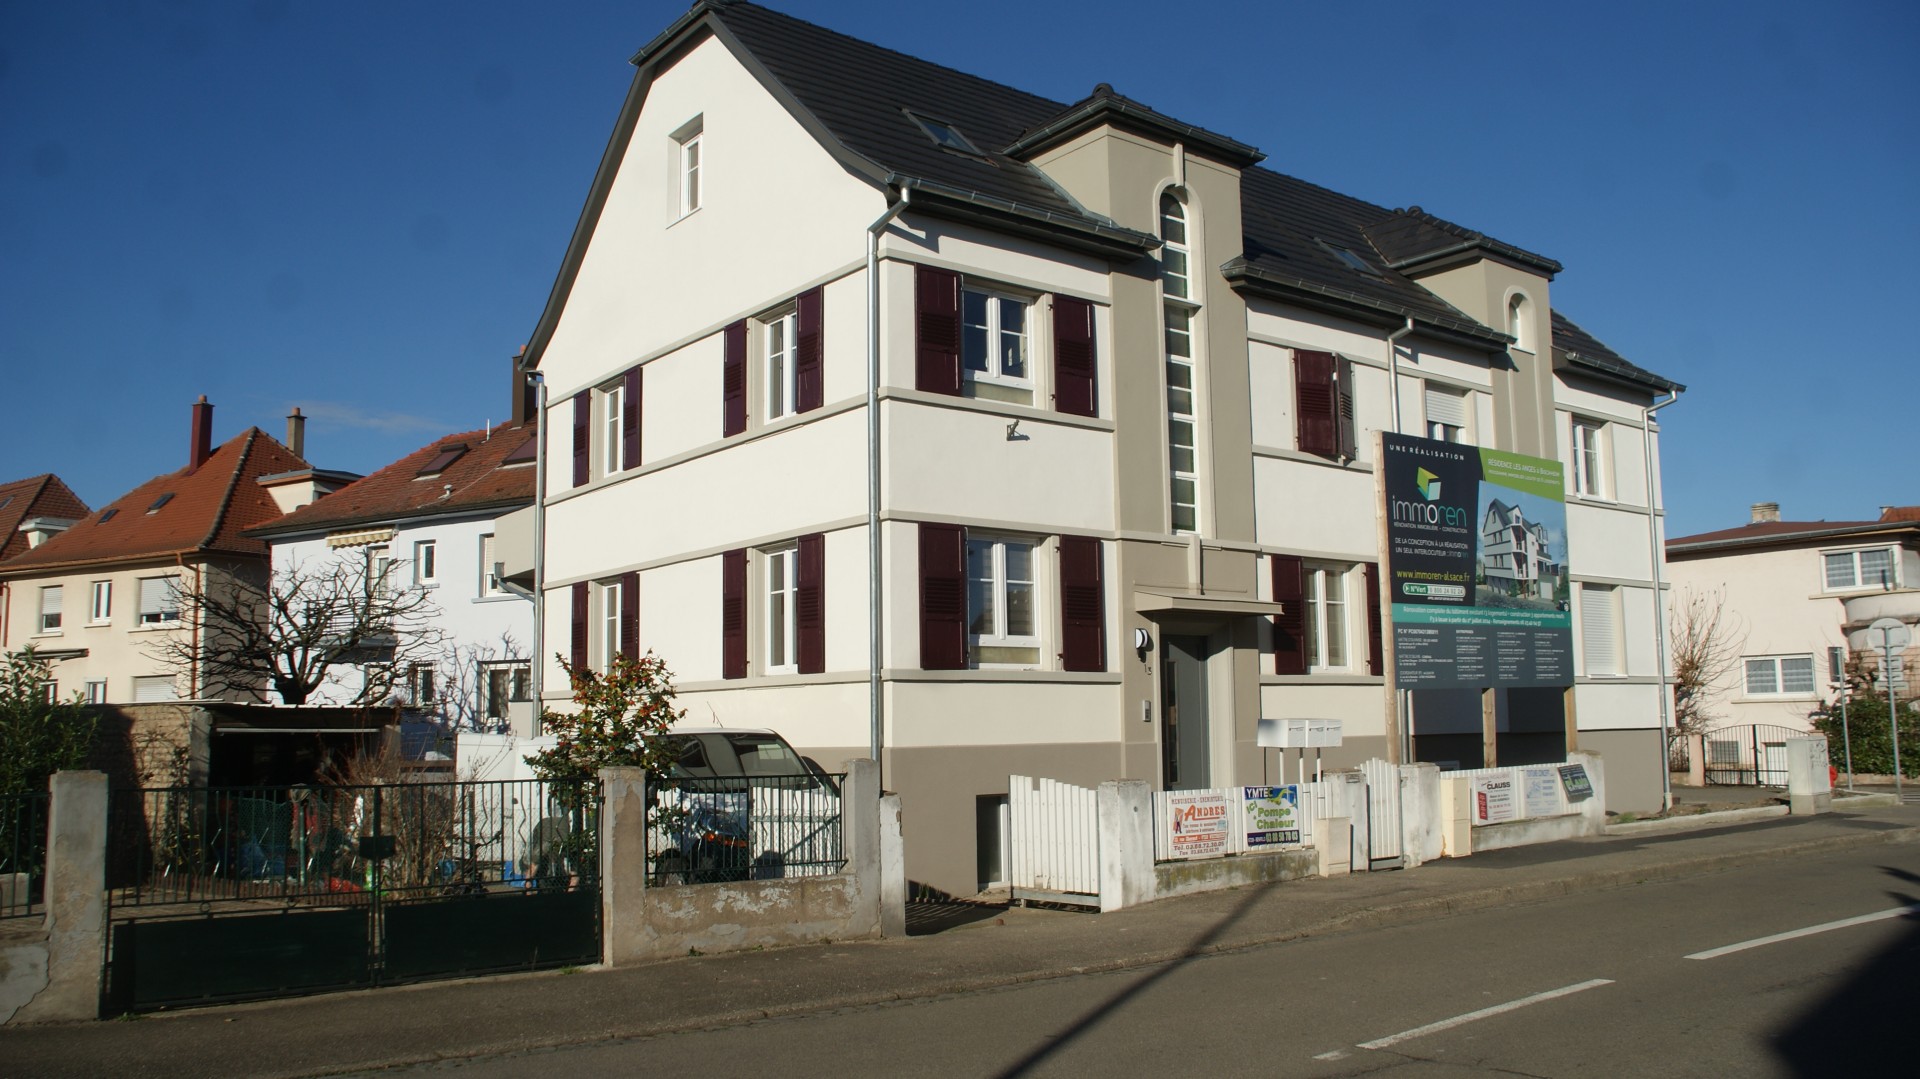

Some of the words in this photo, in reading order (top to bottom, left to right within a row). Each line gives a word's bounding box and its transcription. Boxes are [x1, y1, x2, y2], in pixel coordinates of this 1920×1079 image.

[1389, 444, 1406, 452] UNE
[1409, 446, 1465, 460] RÉALISATION
[1392, 494, 1467, 527] immoren
[1442, 526, 1468, 534] CONSTRUCTION
[1408, 538, 1434, 546] CONCEPTION
[1444, 541, 1468, 549] RÉALISATION
[1397, 570, 1470, 582] www.immoren-alsace.fr
[1487, 782, 1511, 790] CLAUSS
[1247, 787, 1273, 798] YMTEC
[1184, 804, 1225, 821] ANDRES
[1258, 808, 1291, 818] Pompe
[1256, 819, 1295, 829] Chaleur
